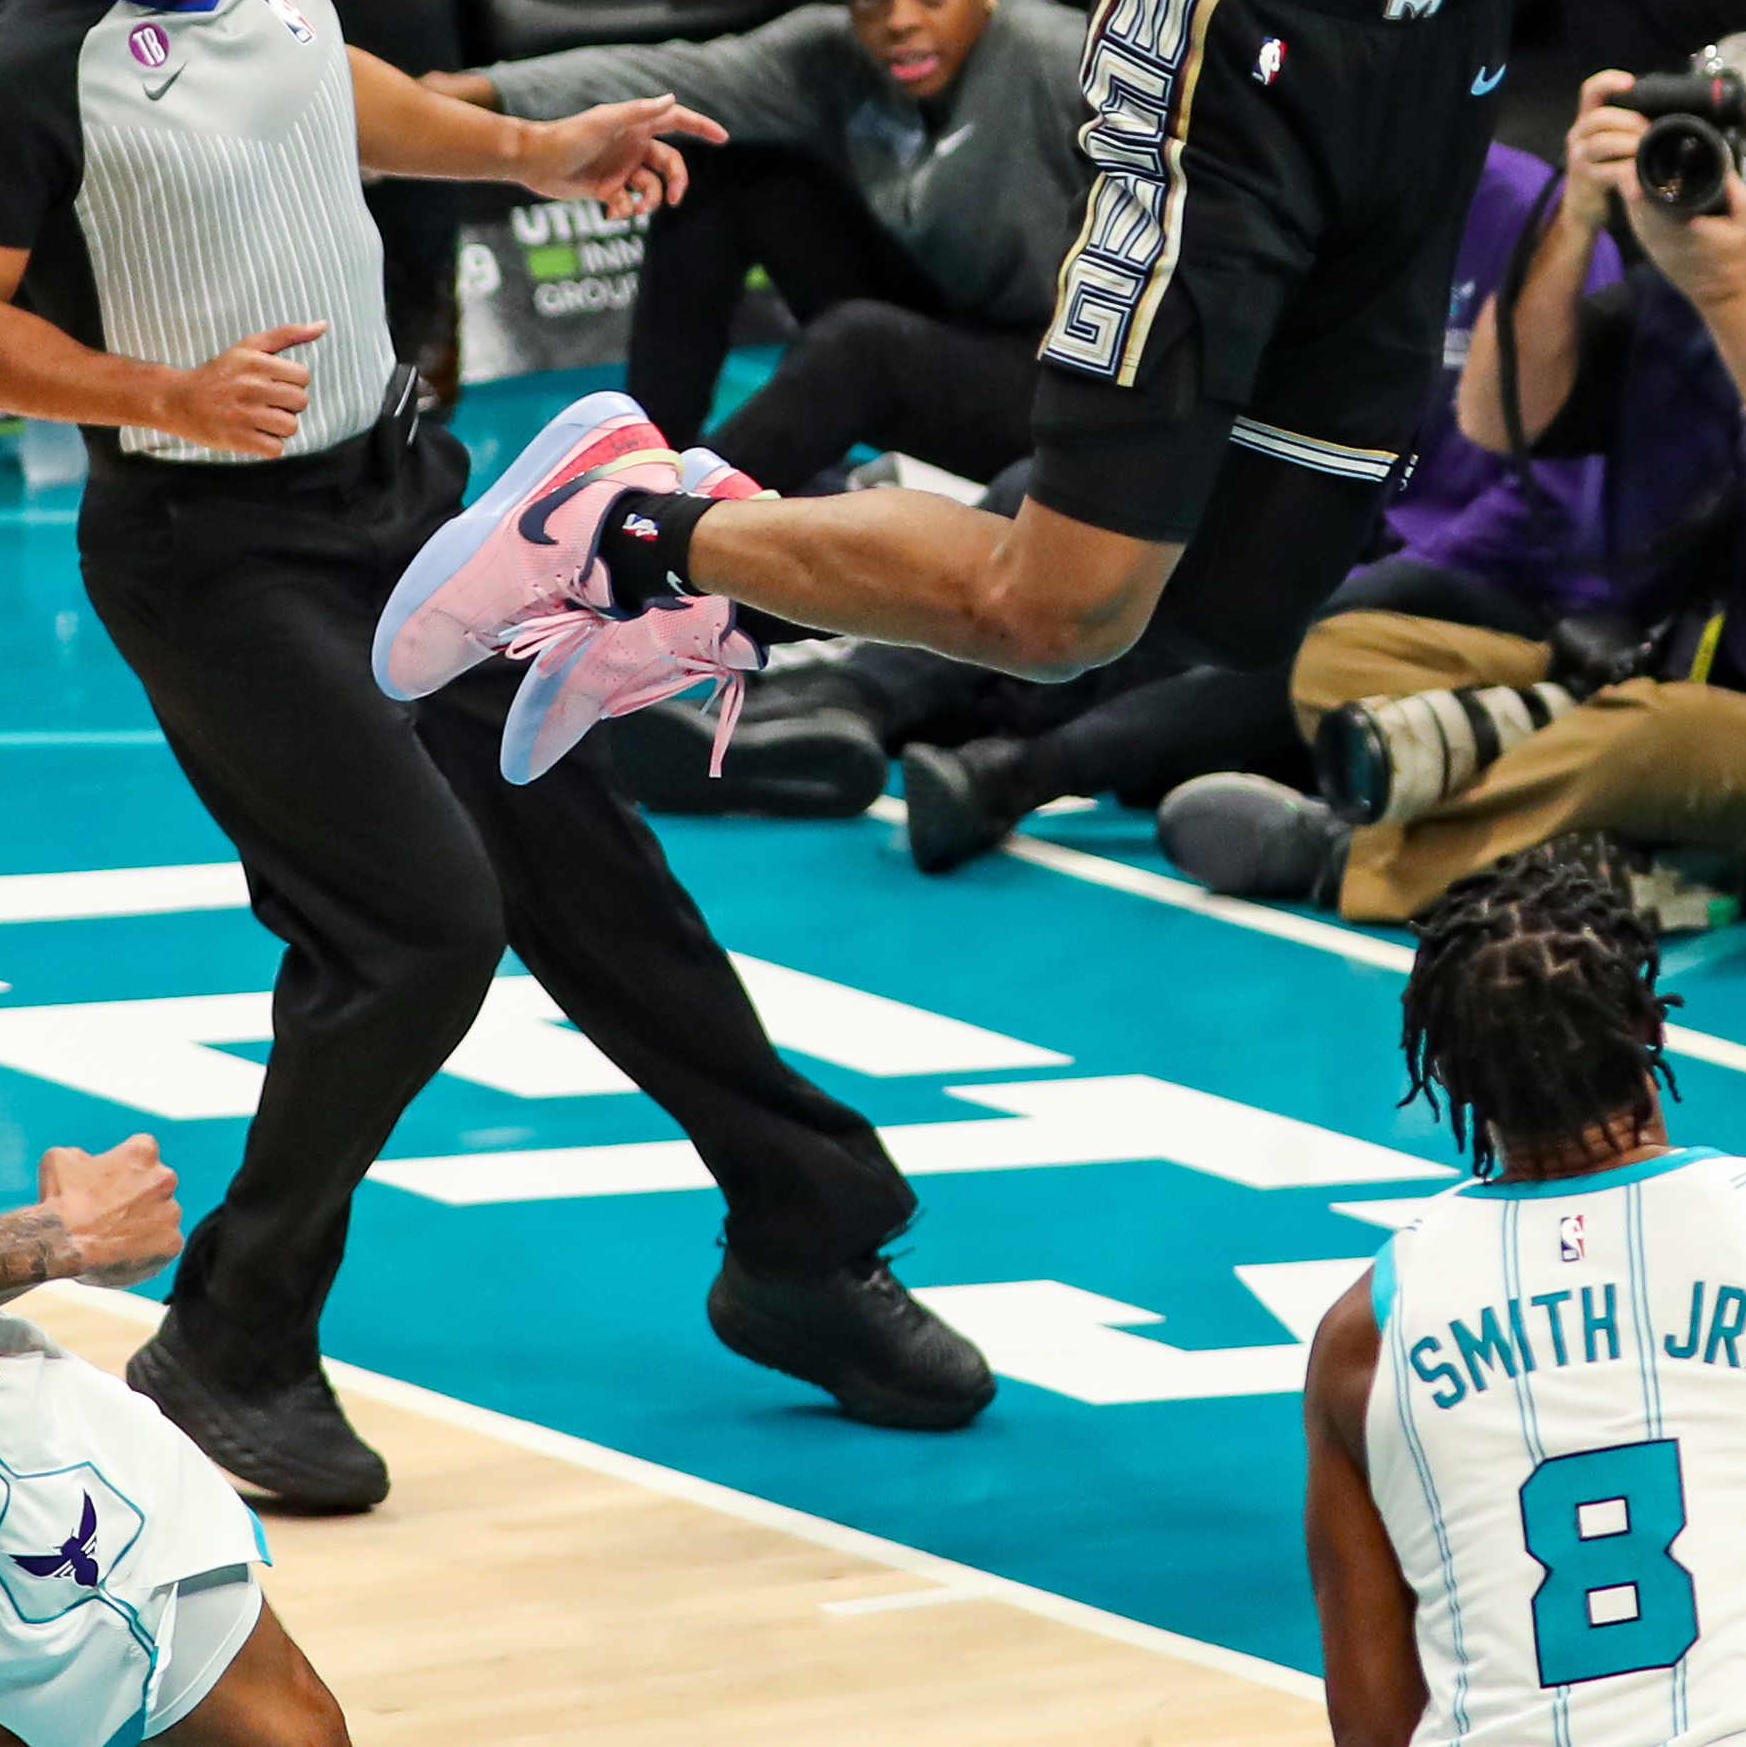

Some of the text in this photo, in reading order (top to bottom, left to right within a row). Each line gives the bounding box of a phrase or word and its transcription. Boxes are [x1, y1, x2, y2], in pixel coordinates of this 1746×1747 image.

[132, 26, 167, 66] TB
[1410, 1282, 1621, 1410] SMITH
[1518, 1438, 1701, 1690] 8
